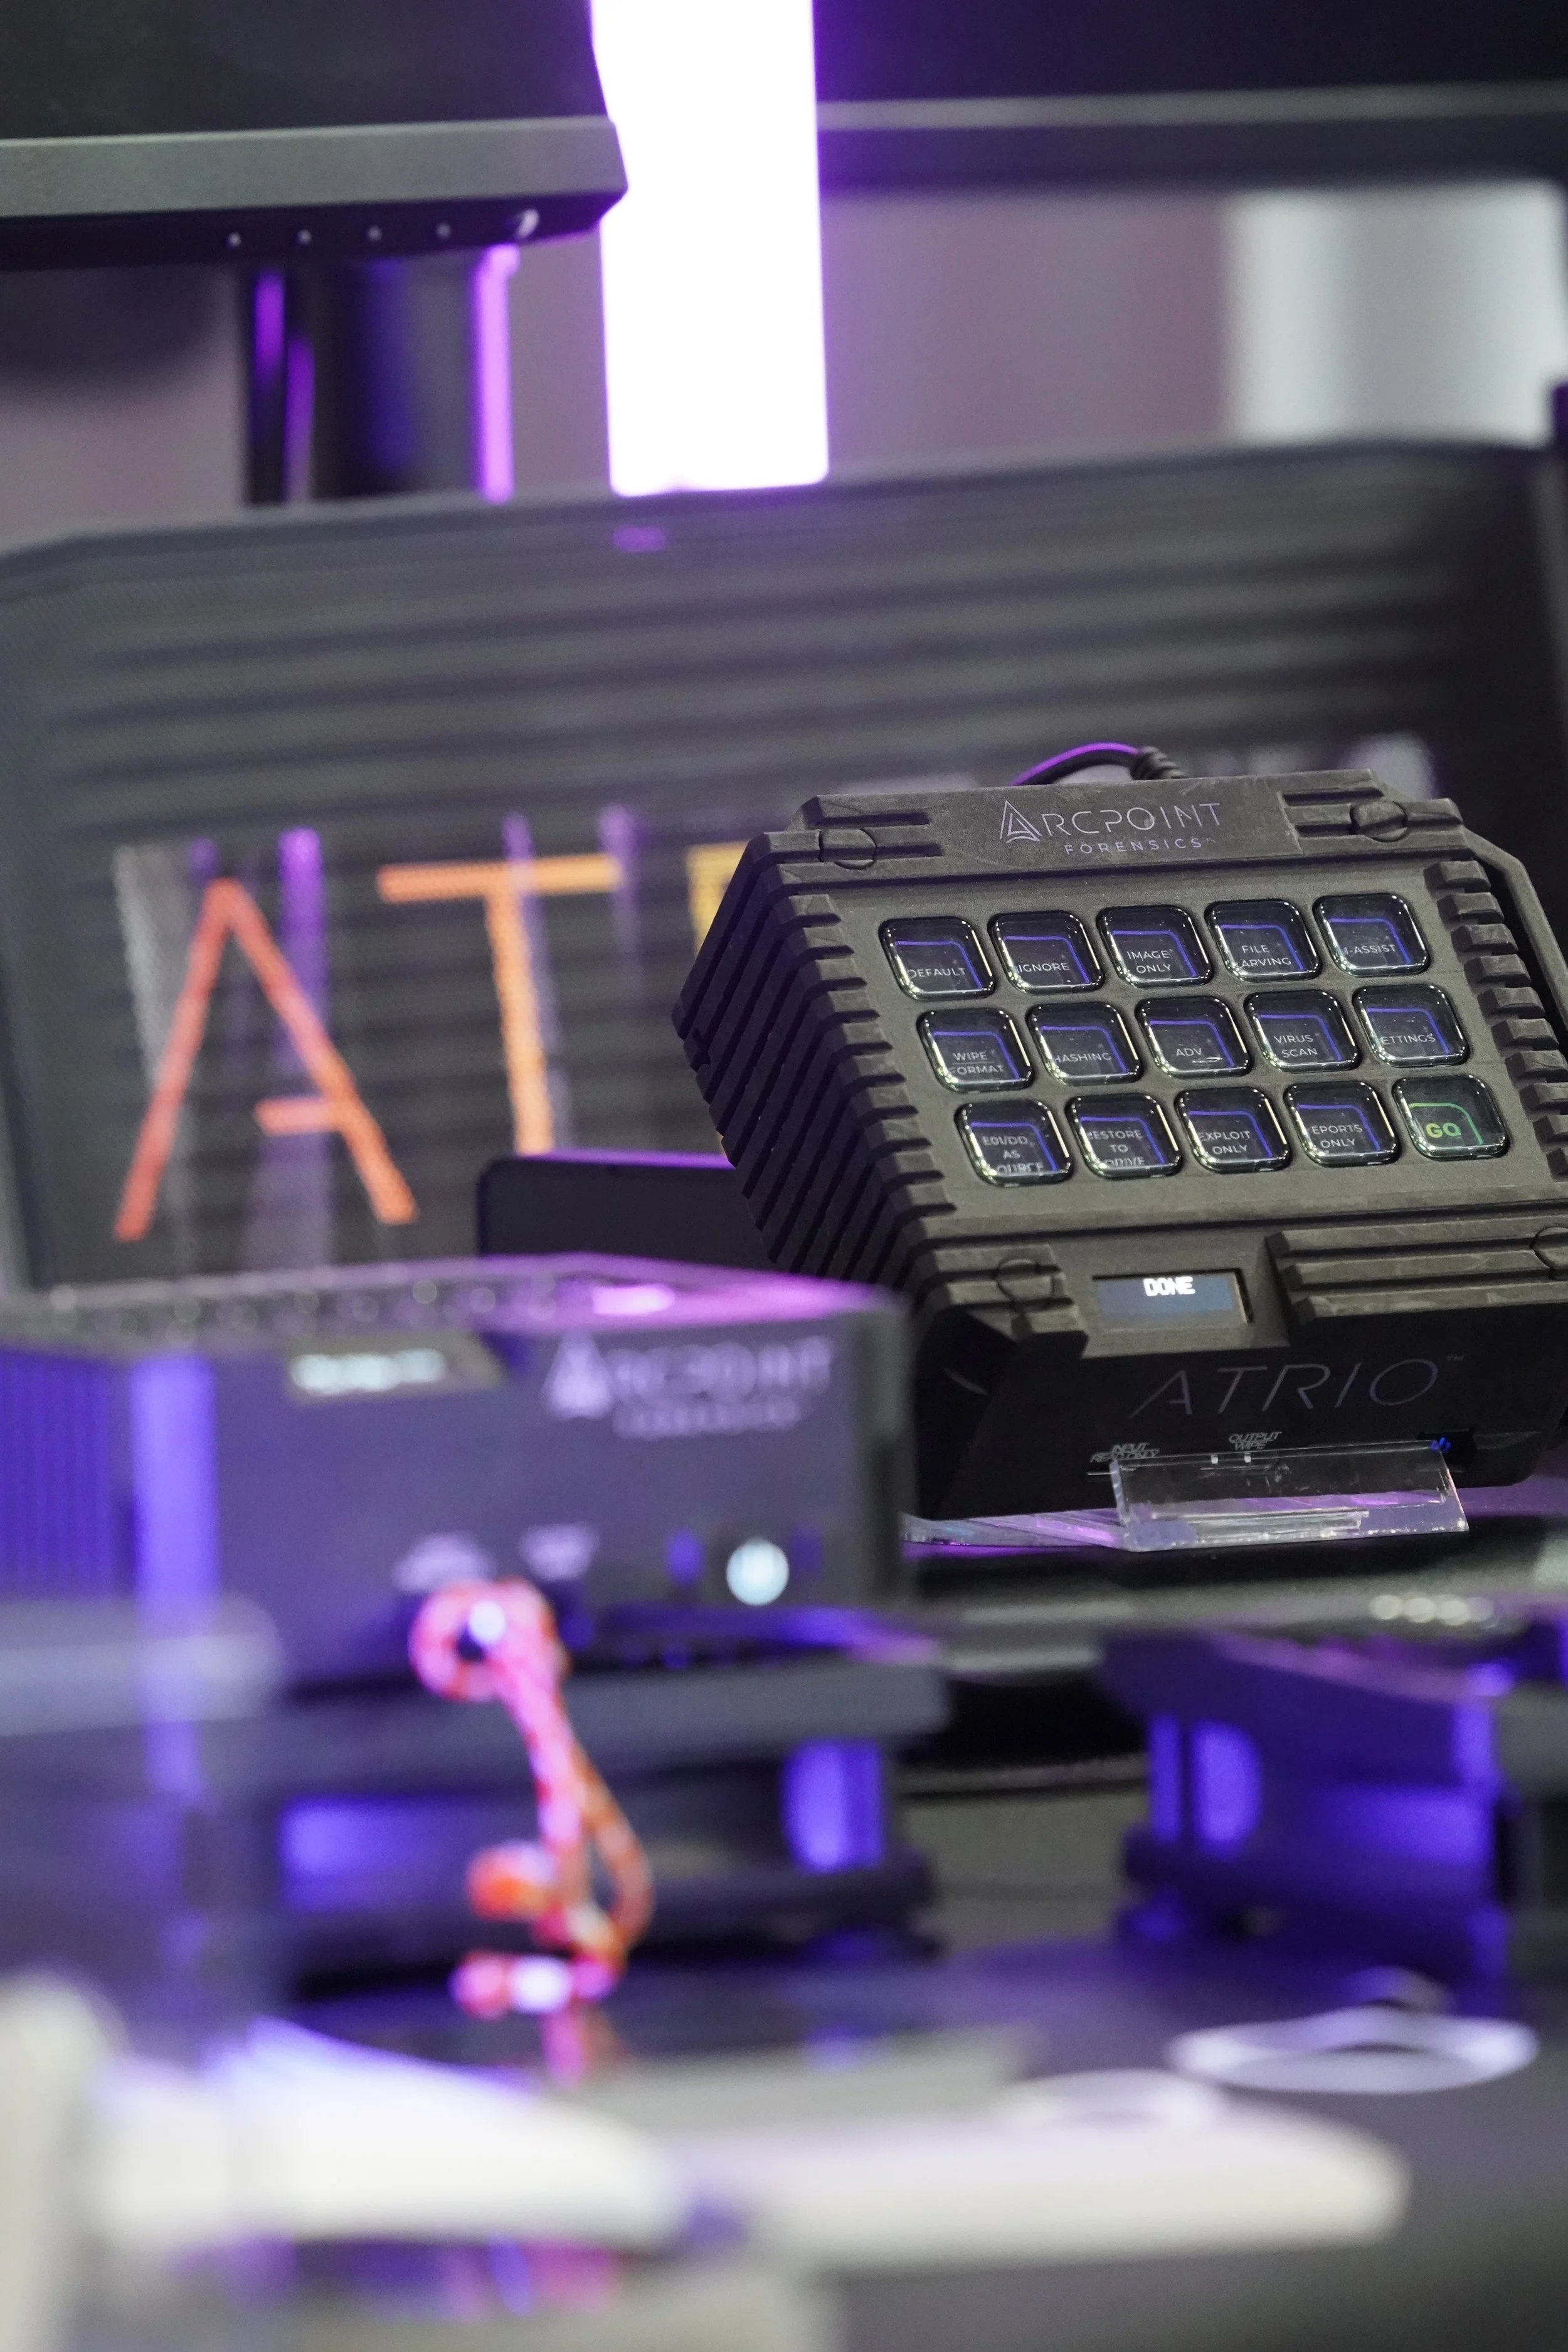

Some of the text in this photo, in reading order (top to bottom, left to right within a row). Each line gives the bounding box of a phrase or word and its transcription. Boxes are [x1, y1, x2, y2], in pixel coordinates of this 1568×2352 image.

[1064, 838, 1202, 855] FORENSICS
[1241, 945, 1269, 953] FILE
[1126, 950, 1170, 960] IMAGE
[1019, 963, 1071, 972] IGNORE
[1240, 957, 1292, 968] ARVING
[1136, 963, 1171, 973] ONLY
[1274, 1034, 1314, 1043] VIRUS
[1381, 1033, 1436, 1045] ETTINGS
[952, 1051, 989, 1061] WIPE
[1176, 1047, 1202, 1056] ADV
[1281, 1048, 1318, 1057] SCAN
[1311, 1124, 1363, 1135] EPORTS
[1426, 1122, 1461, 1138] GO
[1110, 1143, 1129, 1153] TO
[1320, 1138, 1355, 1148] ONLY
[1003, 1149, 1020, 1159] AS
[1212, 1144, 1248, 1155] ONLY
[1142, 1276, 1196, 1296] DONE
[1228, 1431, 1282, 1444] OUTPUT
